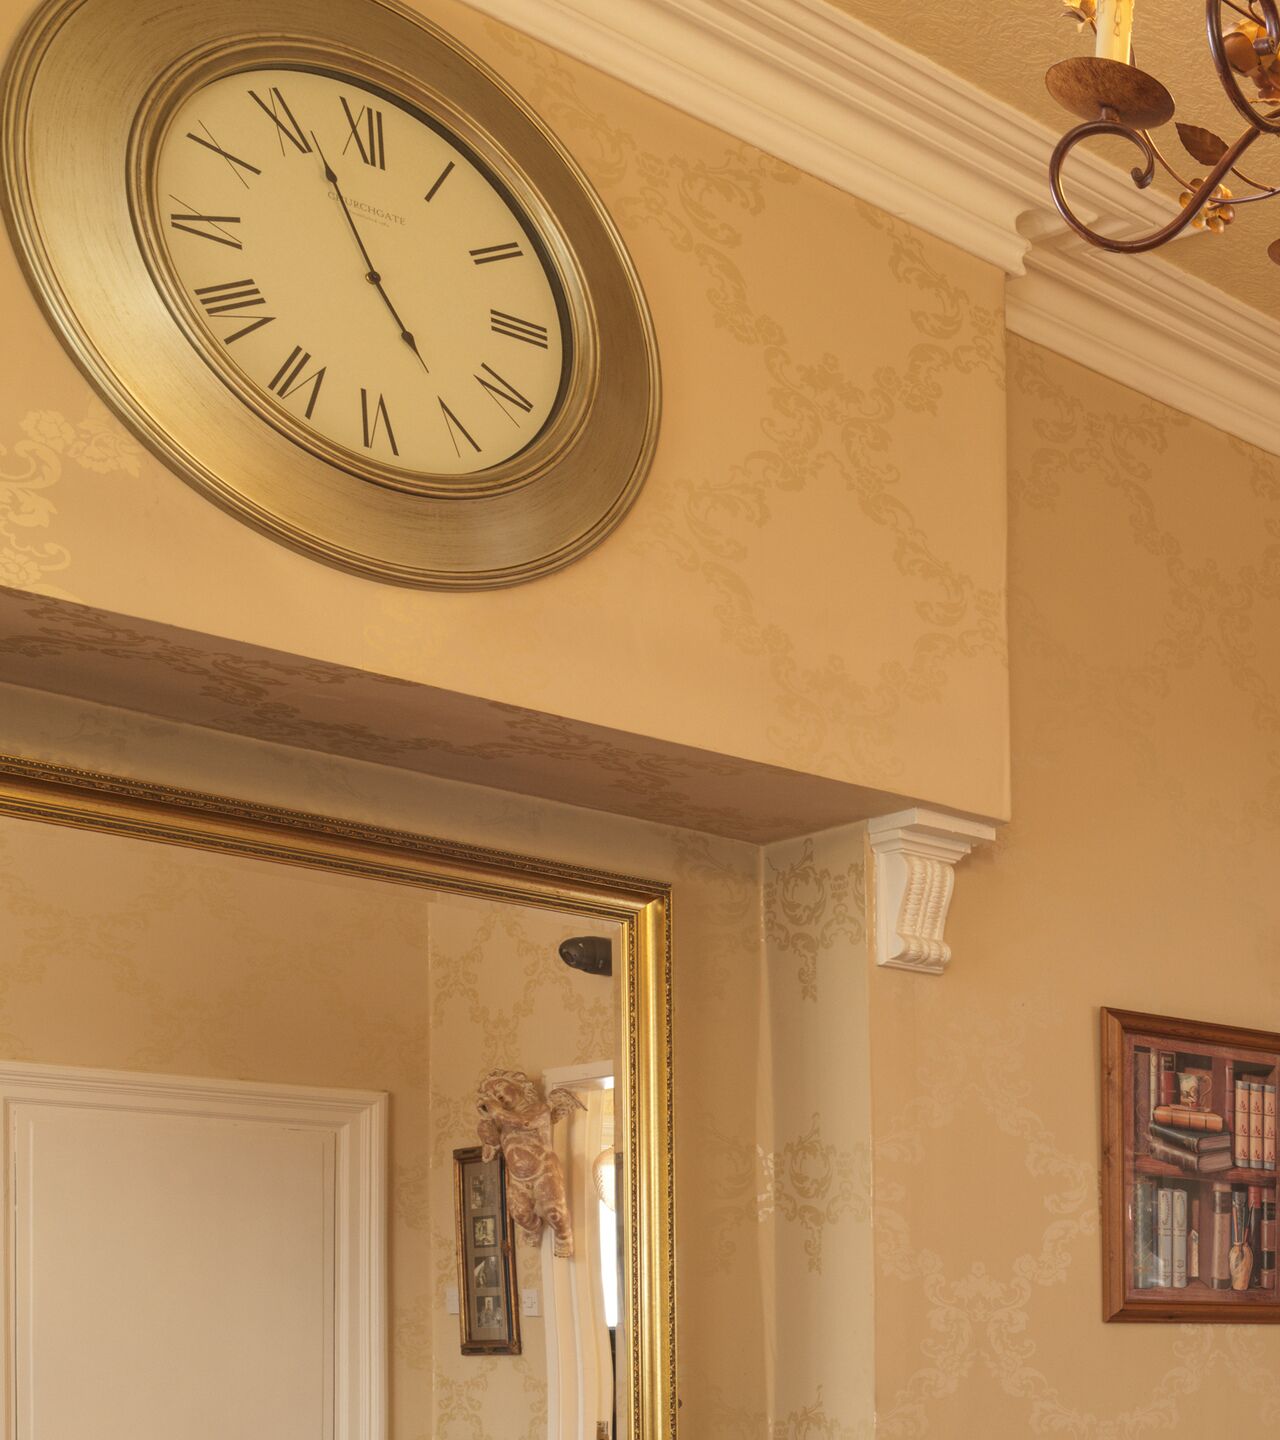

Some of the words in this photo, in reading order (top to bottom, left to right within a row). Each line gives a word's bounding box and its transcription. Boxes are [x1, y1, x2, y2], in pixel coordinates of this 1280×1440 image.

[185, 119, 261, 190] X
[247, 86, 314, 158] XI
[338, 95, 386, 172] XII
[468, 241, 525, 265] II
[193, 278, 277, 346] VIII
[490, 308, 549, 350] III
[267, 345, 328, 421] VII
[473, 362, 535, 430] IV
[360, 387, 400, 458] VI
[437, 395, 482, 459] V
